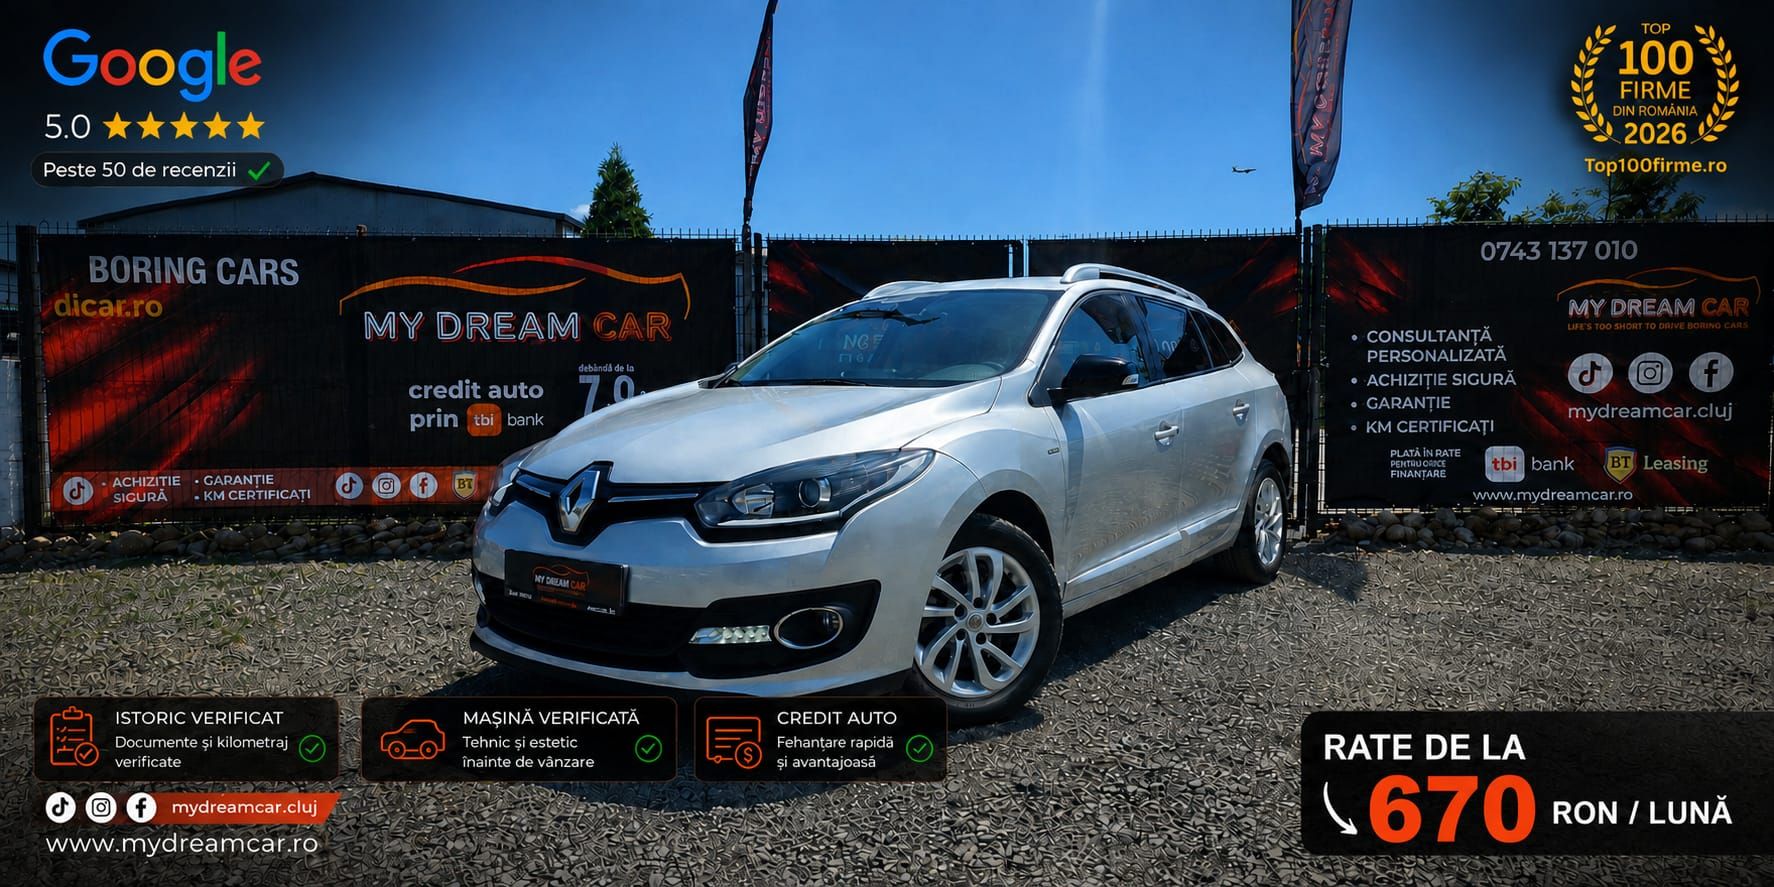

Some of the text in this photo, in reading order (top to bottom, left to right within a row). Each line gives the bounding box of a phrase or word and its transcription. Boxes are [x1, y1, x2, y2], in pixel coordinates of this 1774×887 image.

[1480, 240, 1638, 262] 0743 137 010
[89, 255, 300, 286] BORING CARS
[54, 293, 163, 318] dicar.ro
[1568, 297, 1750, 318] MY DREAM CAR
[363, 311, 672, 342] MY DREAM CAR
[1595, 322, 1612, 330] TOO
[1614, 322, 1643, 330] SHORT
[1645, 322, 1657, 330] TO
[1367, 345, 1507, 363] PERSONALIZATĂ
[614, 363, 625, 372] de
[1451, 370, 1517, 386] SIGURĂ
[408, 380, 544, 400] credit auto
[409, 407, 544, 432] prin tbi bank
[1568, 402, 1733, 422] mydreamcar.cluj
[1366, 421, 1392, 433] KM
[1435, 448, 1461, 457] RATE
[1492, 456, 1575, 472] tbi bank
[1611, 455, 1708, 474] BT Leasing
[456, 478, 473, 489] BT
[113, 489, 168, 503] SIGURĂ
[204, 490, 225, 501] KM
[1473, 488, 1633, 502] www.mydreamcar.ro
[570, 580, 587, 592] CAR
